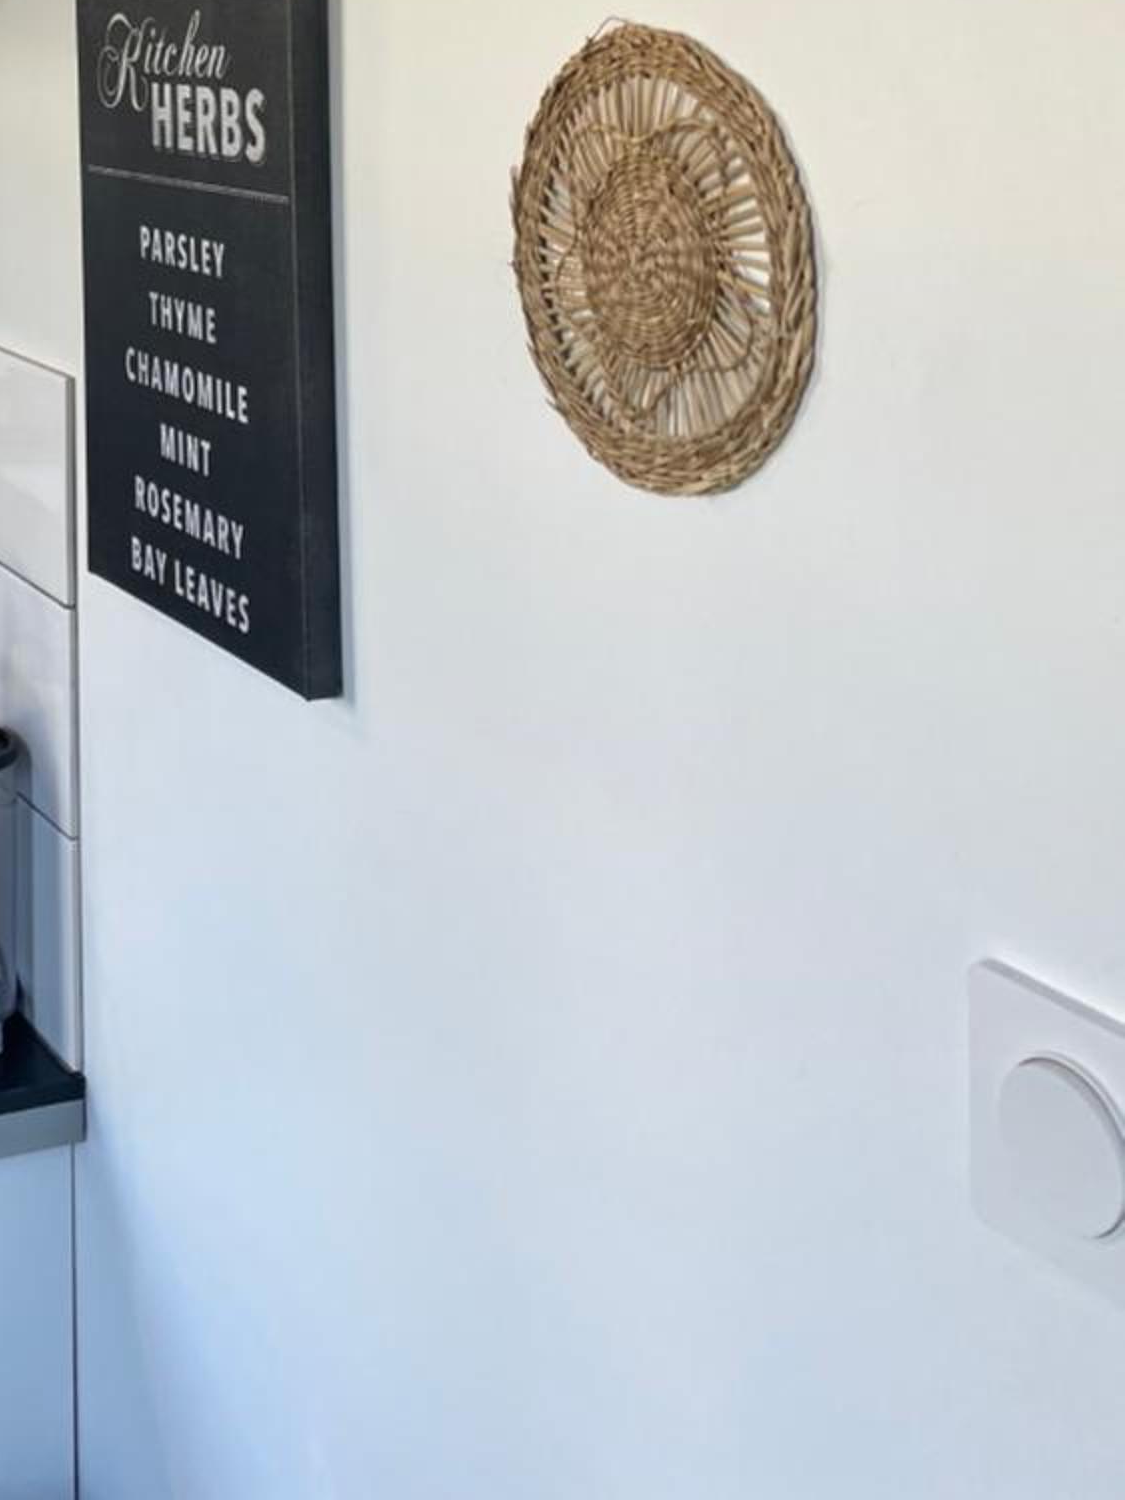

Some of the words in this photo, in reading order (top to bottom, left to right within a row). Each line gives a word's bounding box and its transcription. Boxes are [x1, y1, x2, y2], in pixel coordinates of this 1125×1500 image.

[96, 9, 230, 112] Kitchen
[150, 83, 267, 166] HERBS
[138, 223, 226, 280] PARSLEY
[148, 290, 218, 345] THYME
[124, 345, 249, 425] CHAMOMILE
[159, 422, 212, 479] MINT
[133, 473, 246, 562] ROSEMARY
[130, 535, 167, 589] BAY
[174, 561, 250, 635] LEAVES
